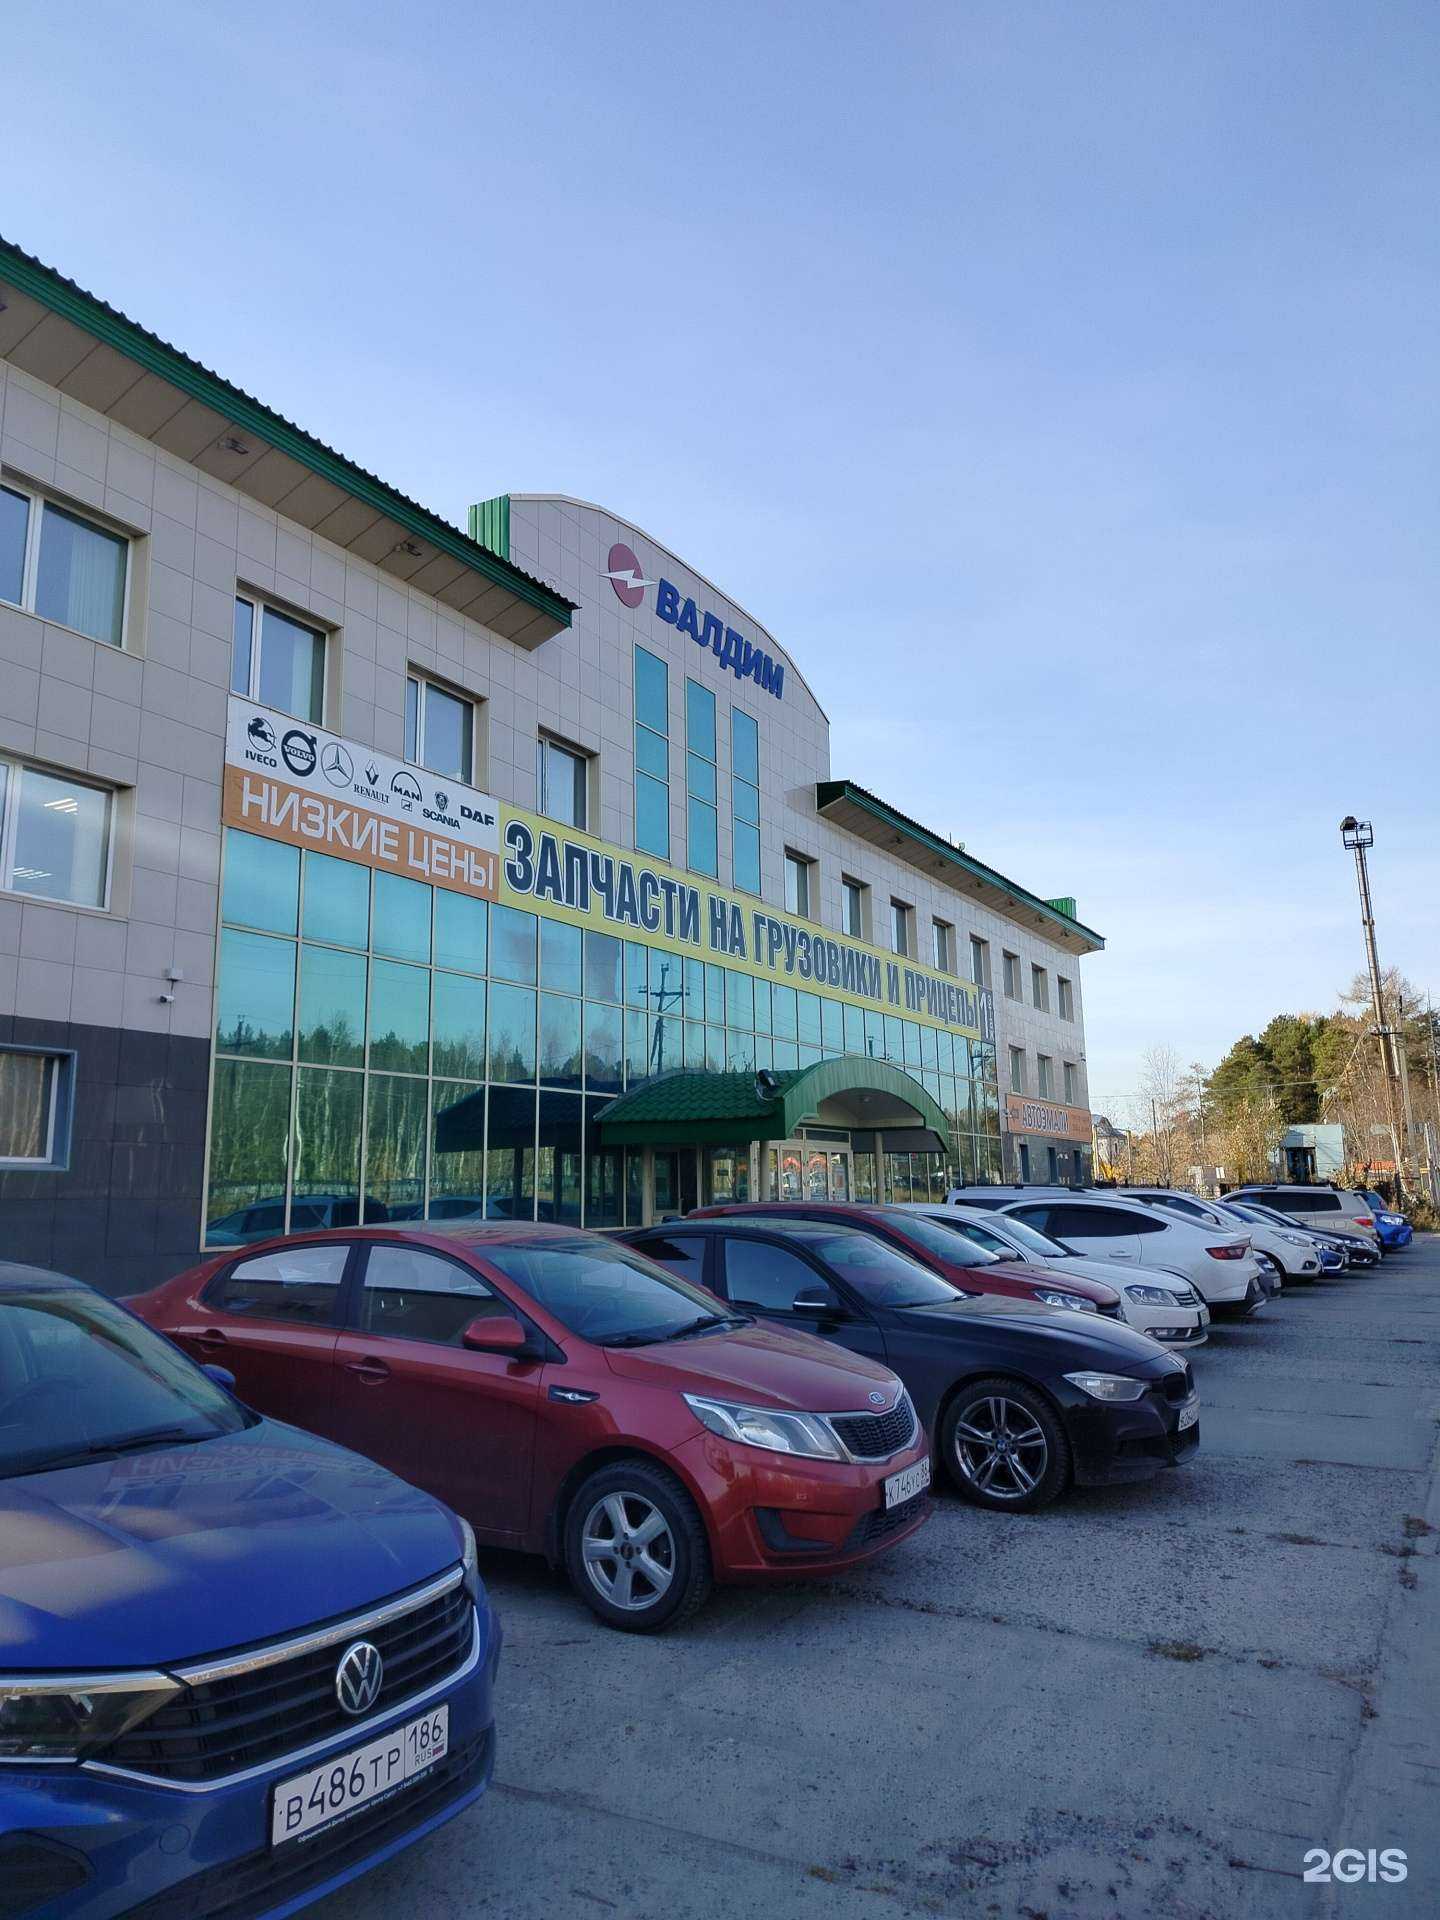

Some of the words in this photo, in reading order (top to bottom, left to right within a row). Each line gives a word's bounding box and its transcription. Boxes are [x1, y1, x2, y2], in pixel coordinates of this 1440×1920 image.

[656, 578, 784, 699] ВАЛДИМ
[245, 750, 277, 768] IVECO
[282, 744, 315, 762] VOLVO
[354, 784, 390, 804] RENAULT
[393, 785, 420, 800] MAN
[422, 808, 461, 830] SCANIA
[460, 805, 494, 827] DAF
[241, 776, 400, 862] НИЗКИЕ
[408, 830, 493, 890] ЦЕНЫ
[504, 820, 701, 946] ЗАПЧАСТИ
[707, 893, 748, 960] НА
[752, 910, 882, 1000] ГРУЗОВИКИ
[886, 960, 900, 1007] И
[903, 966, 979, 1029] ПРИЦЕПЫ
[408, 1713, 443, 1754] 186
[414, 1746, 433, 1767] RUS
